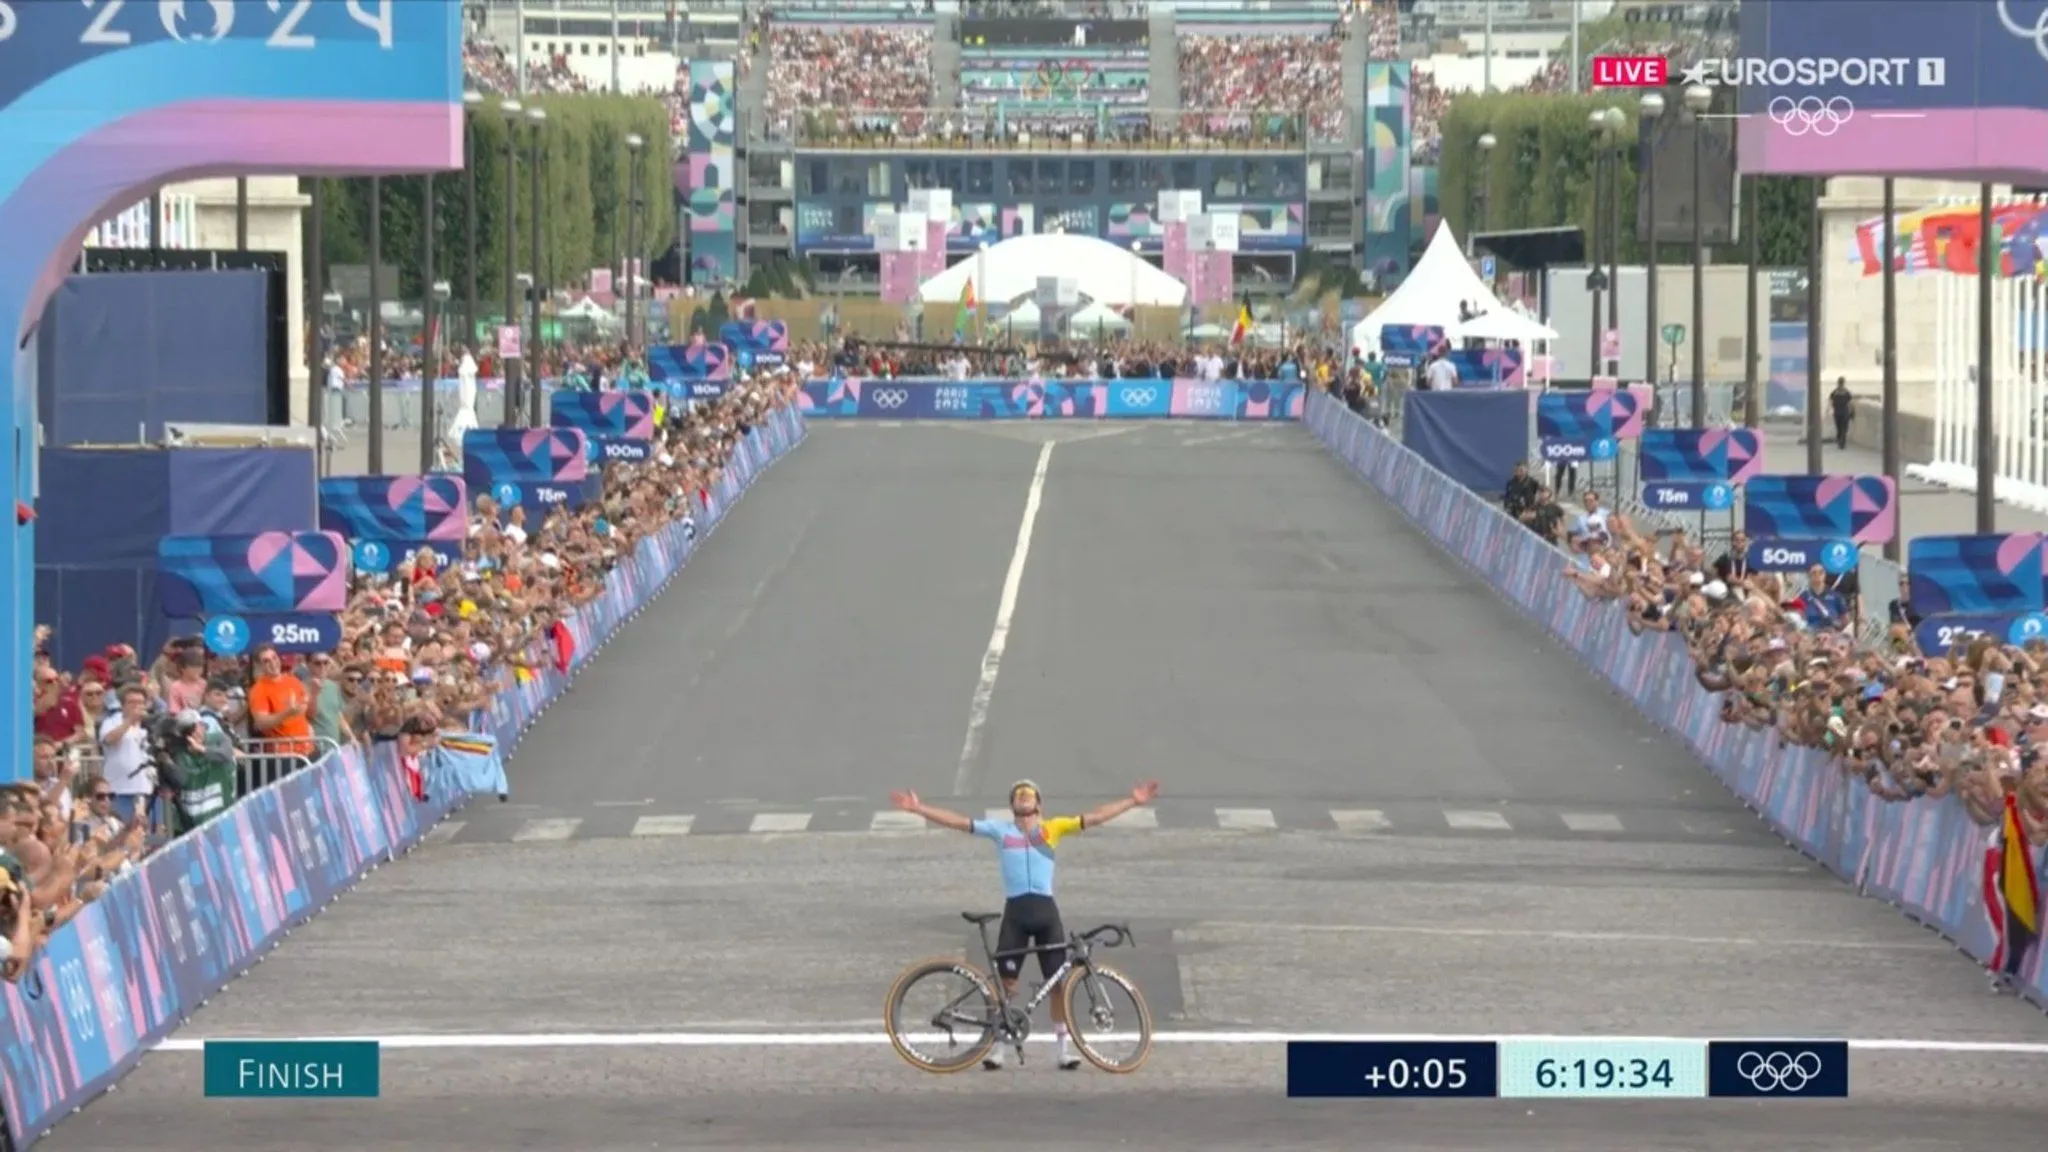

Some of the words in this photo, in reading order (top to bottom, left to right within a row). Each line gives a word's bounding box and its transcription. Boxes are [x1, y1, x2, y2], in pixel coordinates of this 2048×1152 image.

[605, 444, 644, 458] 100m
[1546, 444, 1585, 457] 100m
[536, 487, 568, 502] 75m
[1655, 488, 1689, 504] 75m
[405, 549, 448, 566] 5m
[1762, 548, 1806, 565] 50m
[271, 623, 320, 644] 25m
